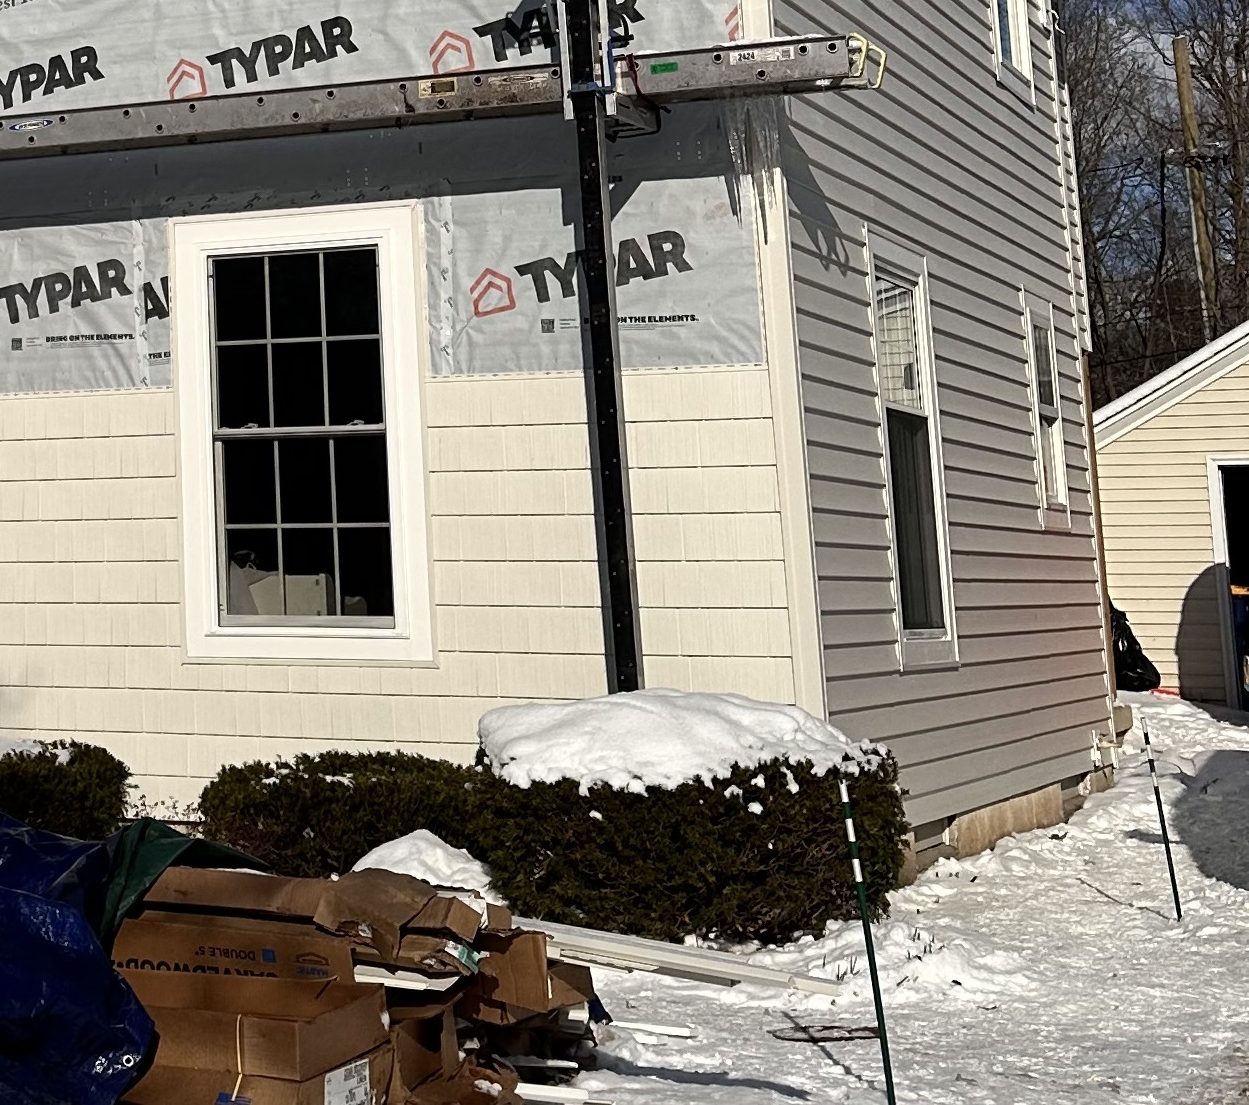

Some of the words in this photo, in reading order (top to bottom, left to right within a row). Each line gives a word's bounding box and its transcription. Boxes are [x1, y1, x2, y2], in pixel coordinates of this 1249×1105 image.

[206, 16, 359, 89] TYPAR
[514, 230, 693, 304] TYAR
[629, 315, 646, 323] THE
[208, 946, 255, 960] DOUBLE
